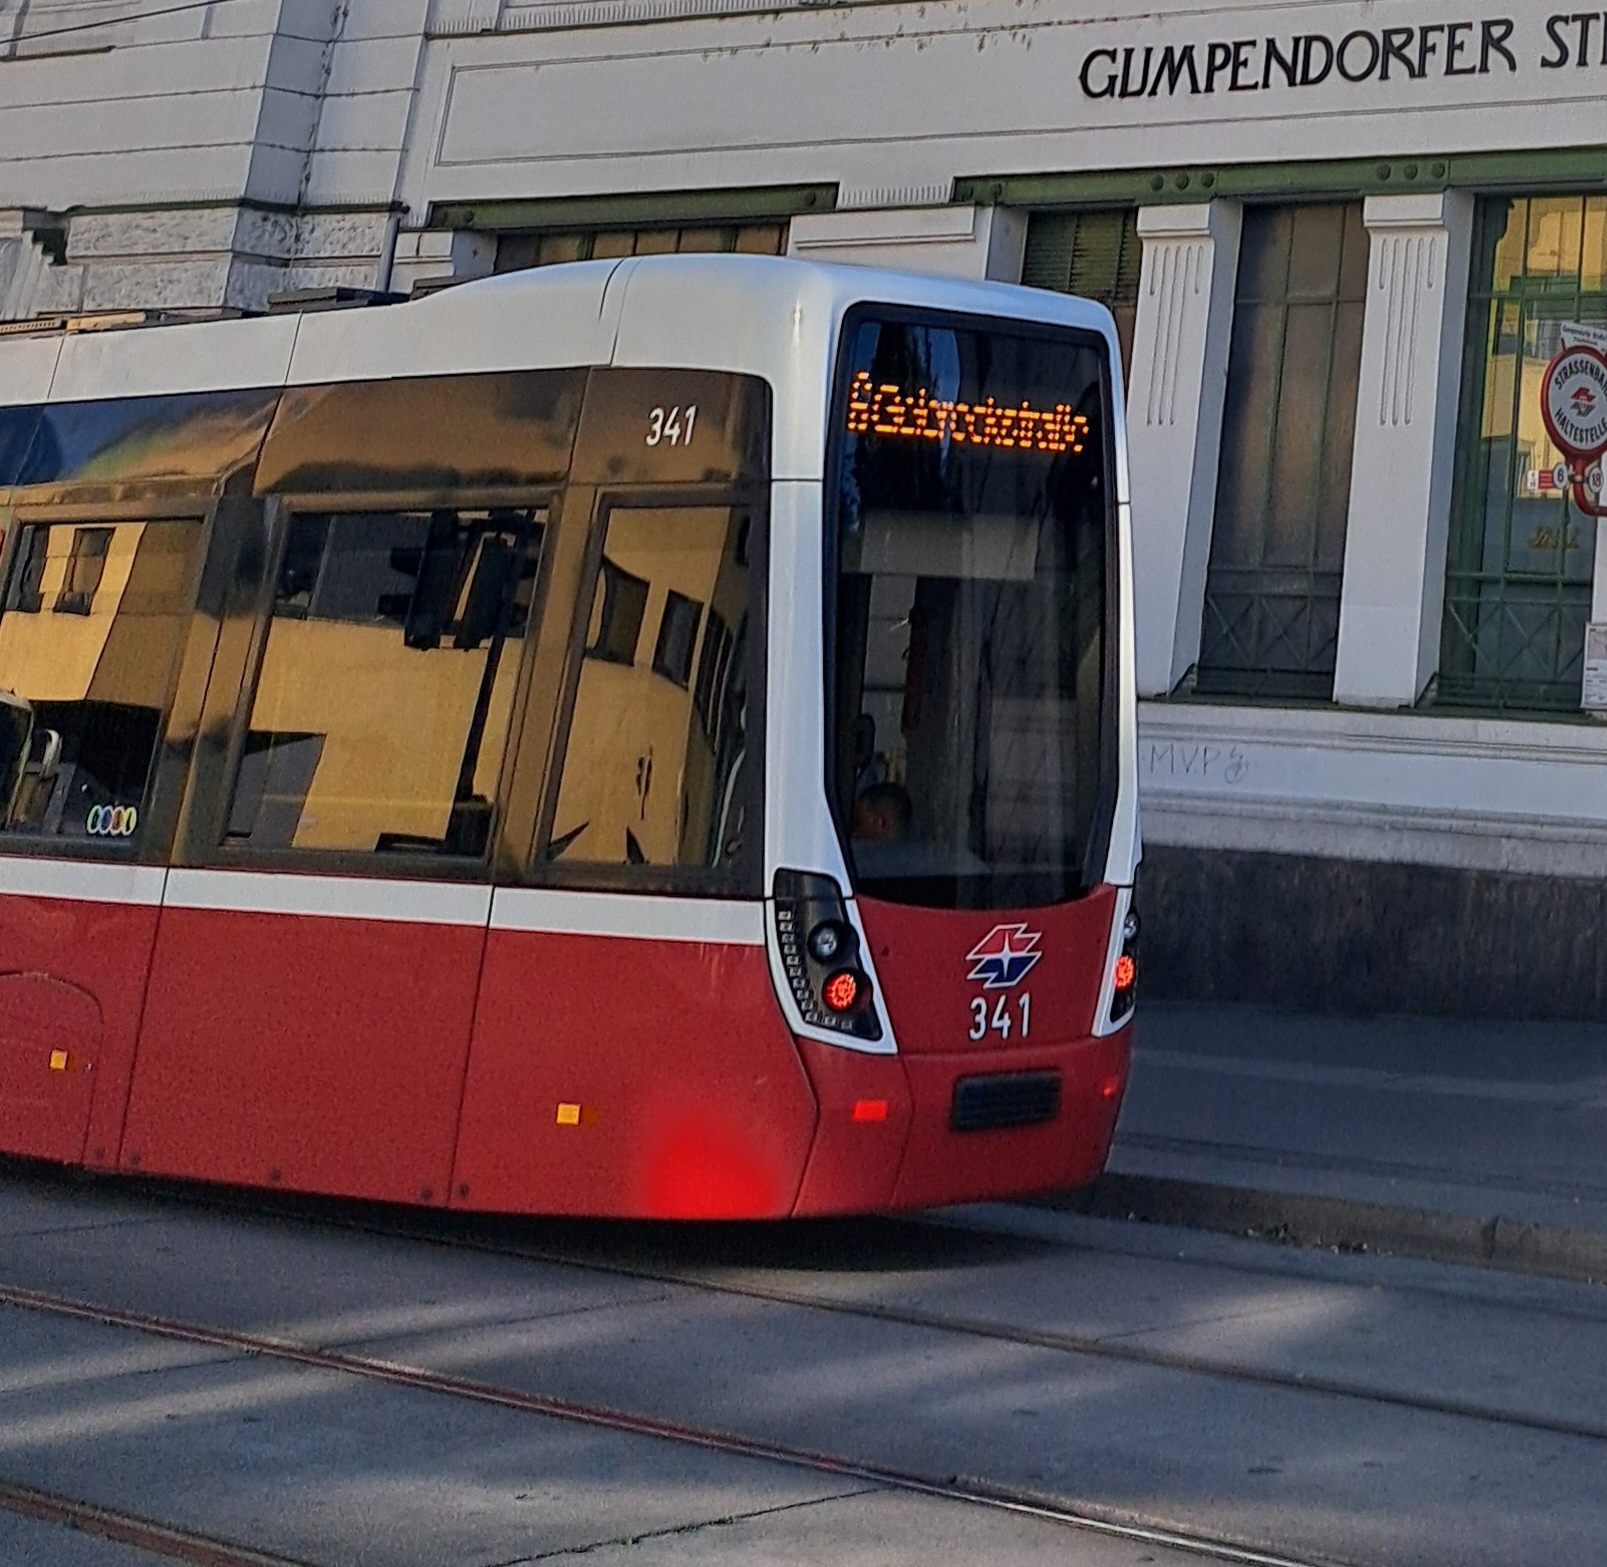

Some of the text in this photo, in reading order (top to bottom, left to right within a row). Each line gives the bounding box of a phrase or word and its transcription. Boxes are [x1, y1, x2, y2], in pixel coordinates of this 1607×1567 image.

[1079, 19, 1516, 99] GUMPENDORFER
[646, 405, 697, 447] 341
[1557, 468, 1564, 483] 6
[1591, 472, 1601, 488] 18
[969, 992, 1031, 1041] 341
